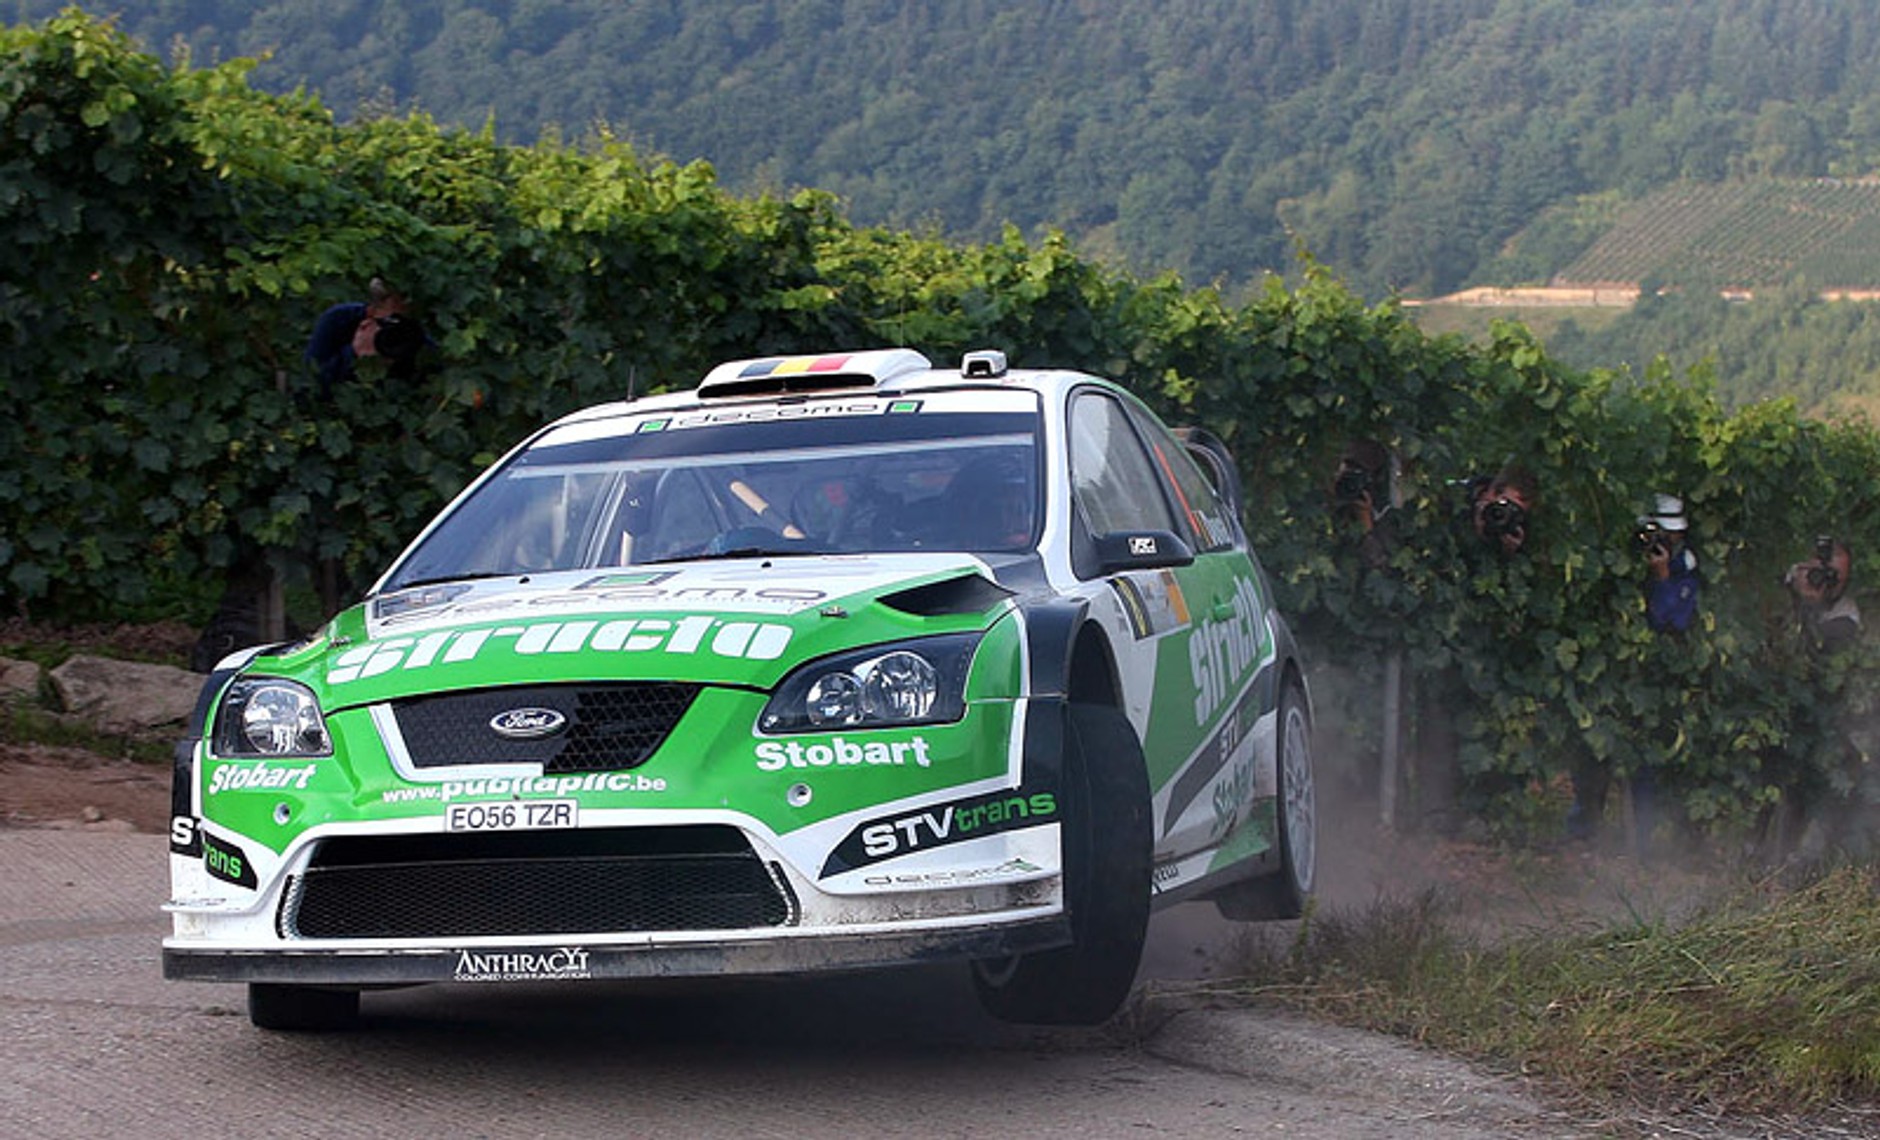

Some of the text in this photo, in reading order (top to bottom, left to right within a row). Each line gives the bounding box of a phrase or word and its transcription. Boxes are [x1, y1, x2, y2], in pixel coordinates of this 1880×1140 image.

[326, 615, 794, 685] structo
[756, 736, 931, 771] Stobart
[209, 762, 316, 794] Stobart
[450, 803, 572, 830] EO56 TZR
